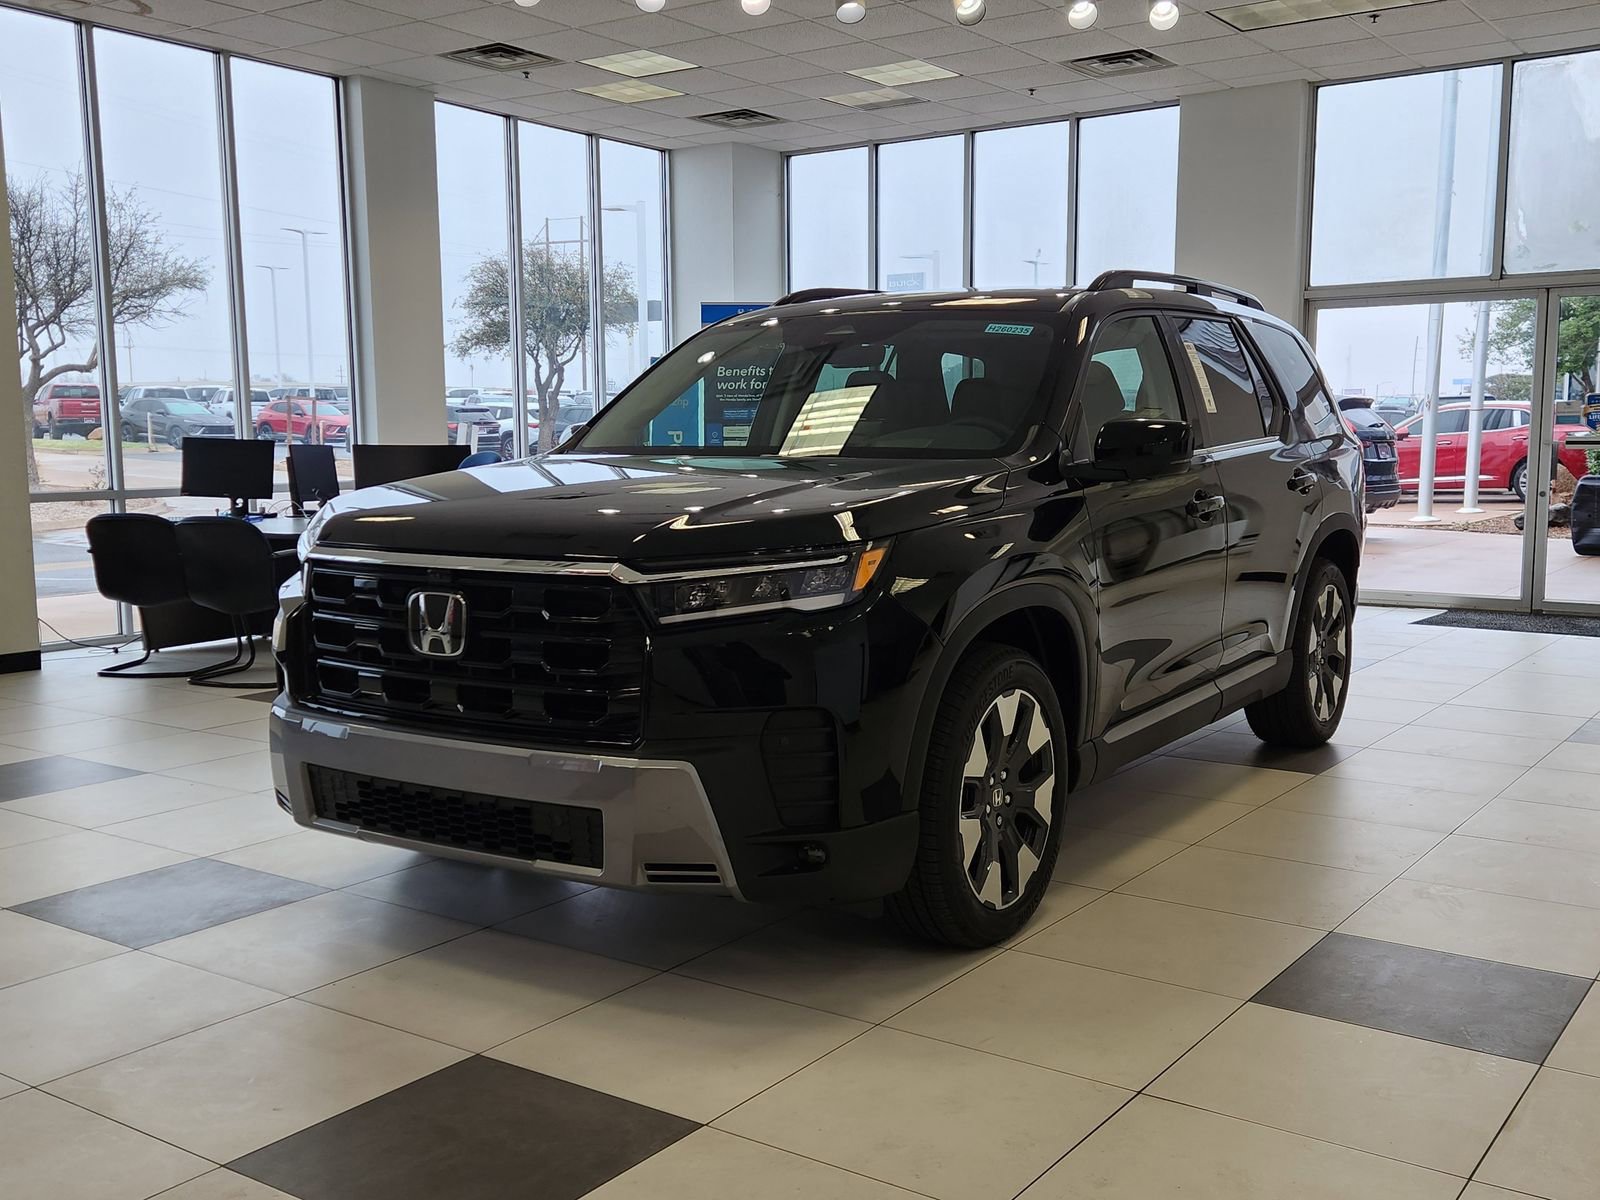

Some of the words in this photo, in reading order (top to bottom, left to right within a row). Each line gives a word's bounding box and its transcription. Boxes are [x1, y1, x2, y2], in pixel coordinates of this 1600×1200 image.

[987, 325, 1032, 334] H260235
[717, 365, 766, 377] Benefits
[717, 378, 748, 390] work
